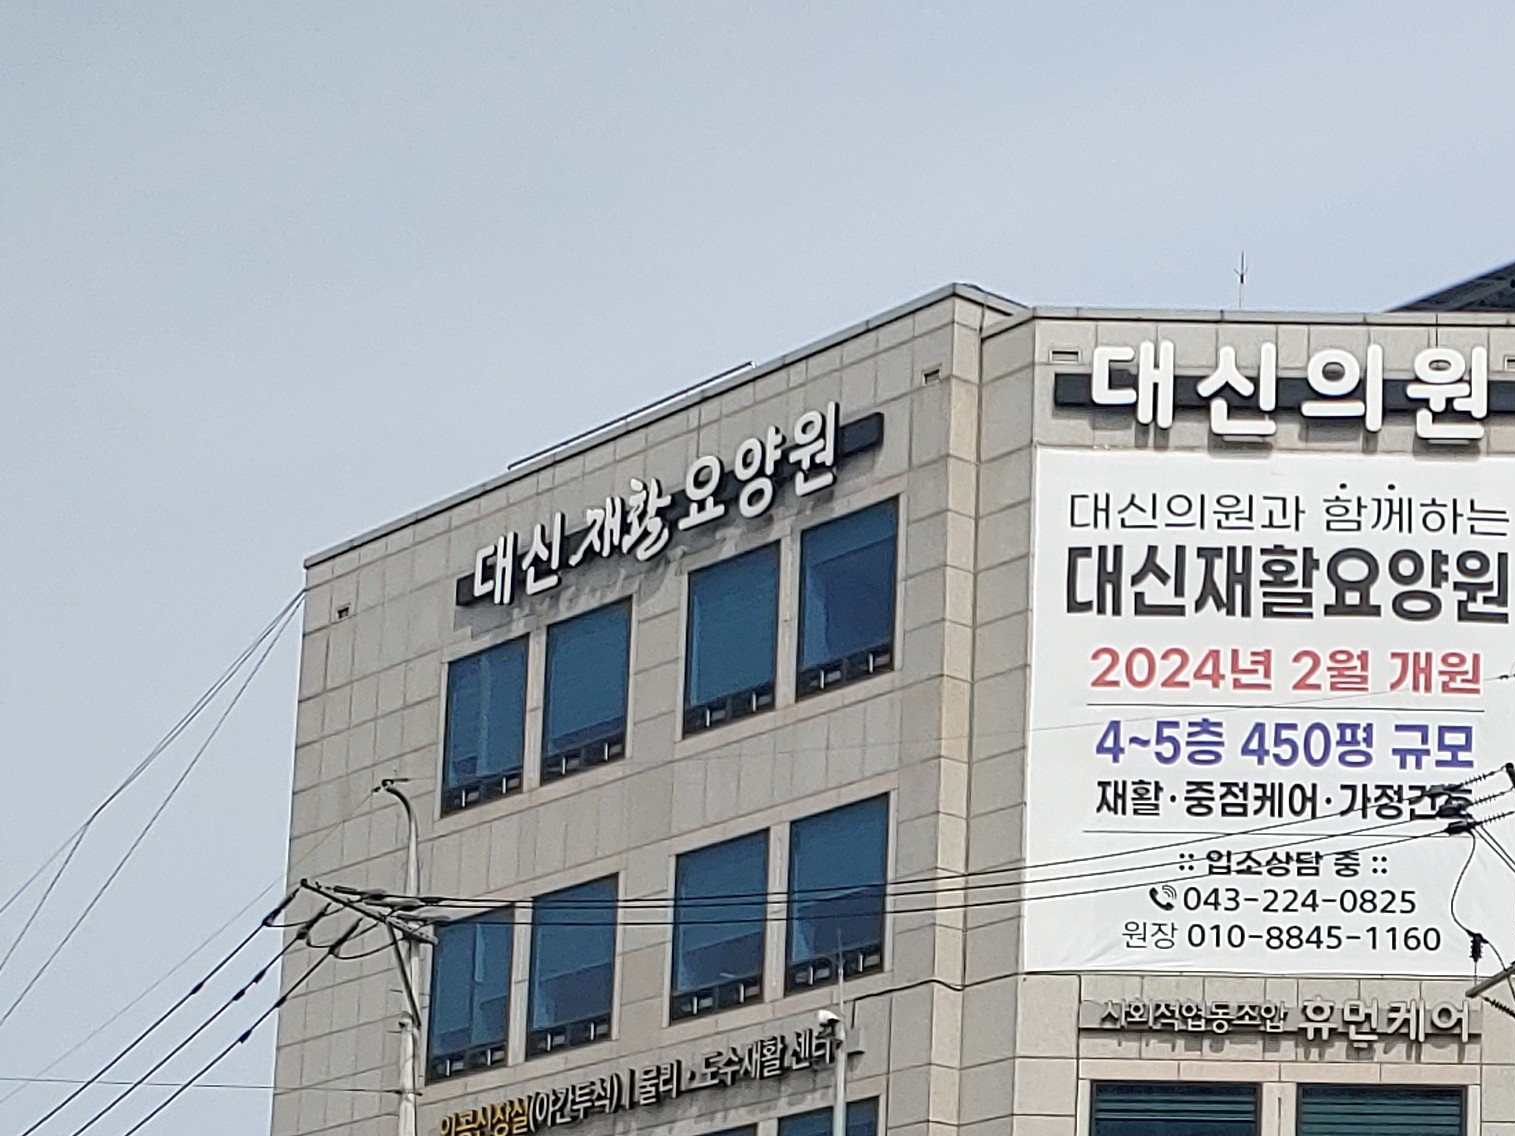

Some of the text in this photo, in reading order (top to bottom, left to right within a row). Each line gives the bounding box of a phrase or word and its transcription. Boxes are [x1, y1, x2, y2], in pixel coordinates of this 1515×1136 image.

[1091, 341, 1488, 442] 대신의원
[1069, 493, 1511, 536] 대신의원과 함께하는
[1065, 544, 1510, 624] 대신재활요양원
[1089, 647, 1482, 695] 2024년 2월 개원
[1095, 720, 1475, 770] 4~5층 450평 규모
[1096, 780, 1473, 822] 재활·중점케어·가정간
[1205, 850, 1361, 878] 입소상담 중
[1183, 887, 1416, 915] 043-224-0825
[1121, 921, 1442, 951] 원장 010-8845-1160
[1298, 995, 1469, 1043] 휴먼케어
